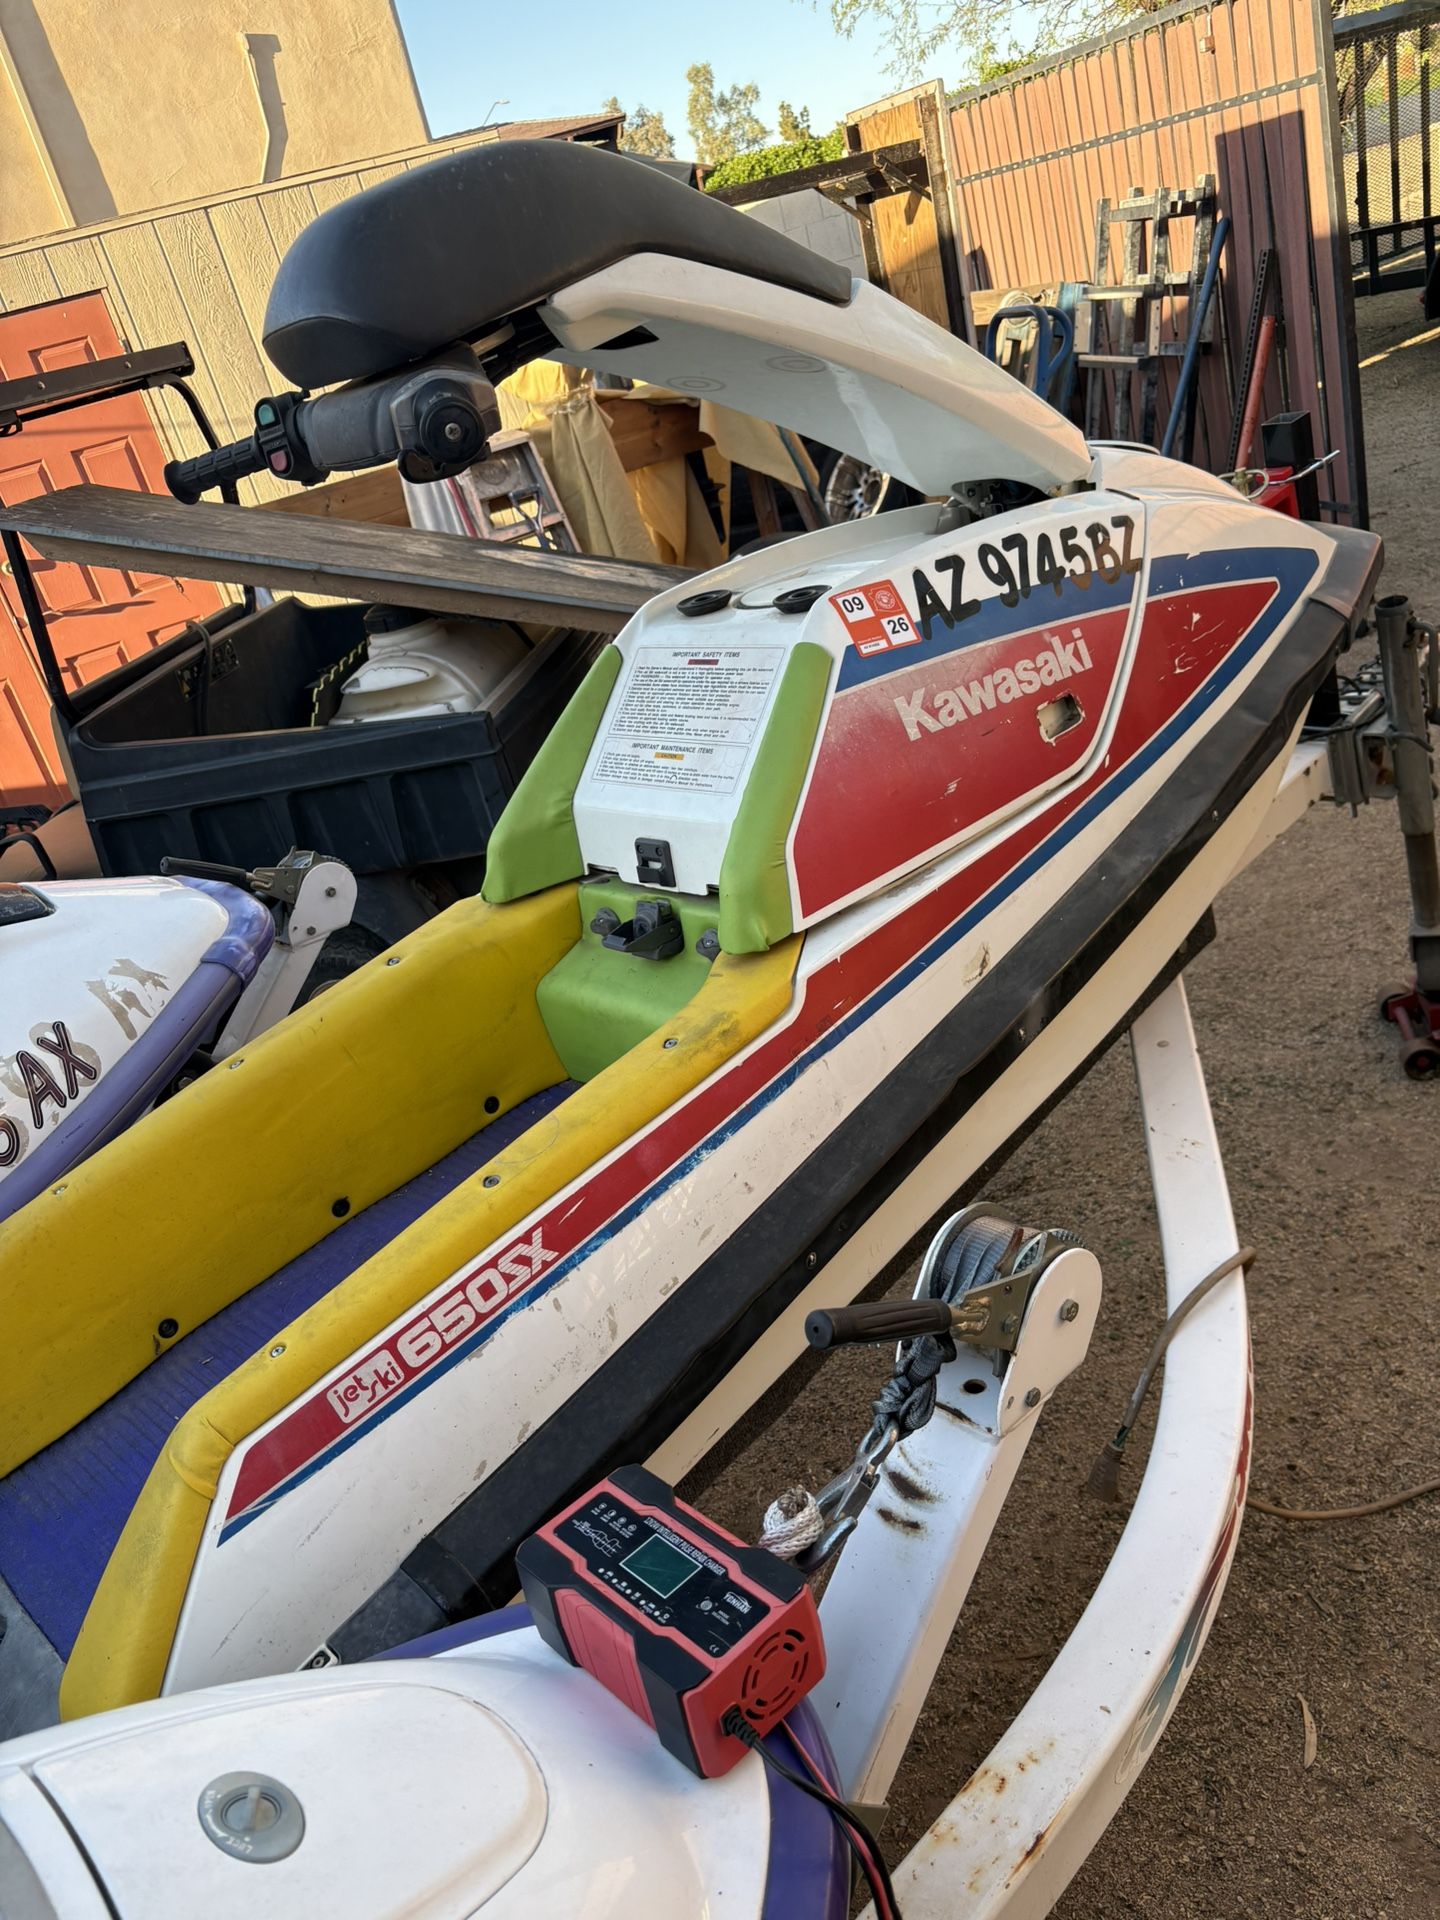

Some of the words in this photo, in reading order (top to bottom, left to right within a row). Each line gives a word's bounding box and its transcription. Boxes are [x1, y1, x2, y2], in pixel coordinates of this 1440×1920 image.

[912, 554, 981, 640] AZ
[977, 515, 1143, 608] 9745BZ
[842, 596, 864, 613] 09
[887, 617, 909, 635] 26
[894, 627, 1093, 742] Kawasaki
[631, 742, 660, 751] IMPORTANT
[660, 744, 696, 753] MAINTENANCE
[396, 1226, 560, 1368] 650SX
[703, 1557, 726, 1576] CHARGER
